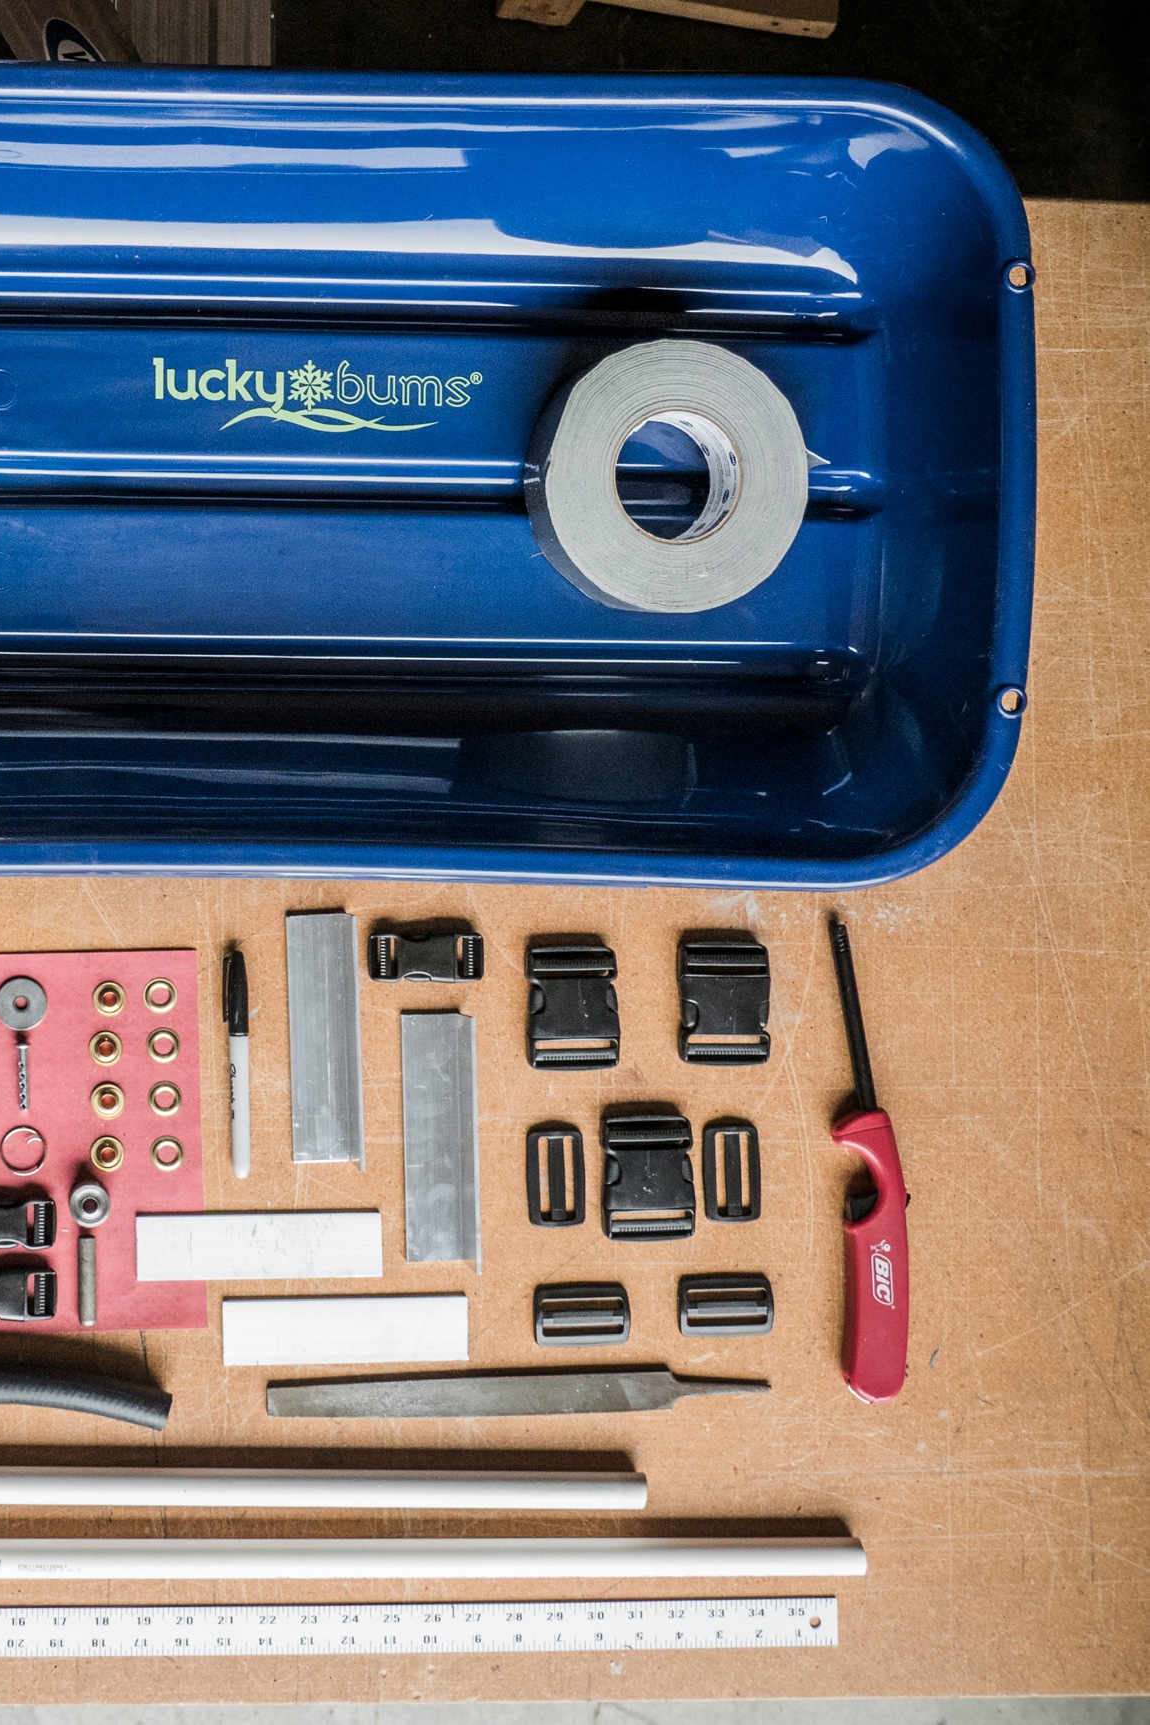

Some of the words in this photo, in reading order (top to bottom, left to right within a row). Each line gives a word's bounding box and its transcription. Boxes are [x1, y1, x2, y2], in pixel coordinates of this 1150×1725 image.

[153, 357, 285, 412] lucky
[11, 1618, 26, 1626] 16
[95, 1617, 109, 1625] 18
[137, 1617, 151, 1625] 19
[176, 1616, 193, 1625] 20
[218, 1616, 234, 1624] 21
[259, 1616, 276, 1624] 22
[301, 1615, 317, 1624] 23
[342, 1615, 359, 1623] 24
[383, 1614, 400, 1623] 25
[424, 1614, 441, 1622] 26
[465, 1614, 481, 1622] 27
[506, 1613, 523, 1621] 28
[587, 1612, 604, 1620] 30
[628, 1611, 643, 1619] 31
[668, 1610, 684, 1618] 32
[709, 1609, 725, 1618] 33
[749, 1608, 765, 1617] 34
[788, 1608, 805, 1616] 35
[7, 1639, 24, 1648] 20
[50, 1639, 64, 1648] 19
[92, 1639, 106, 1647] 18
[134, 1639, 148, 1647] 17
[175, 1638, 190, 1646] 16
[217, 1638, 231, 1646] 15
[258, 1637, 272, 1646] 14
[300, 1637, 314, 1645] 13
[341, 1636, 355, 1645] 12
[384, 1636, 396, 1644] 11
[424, 1635, 438, 1644] 10
